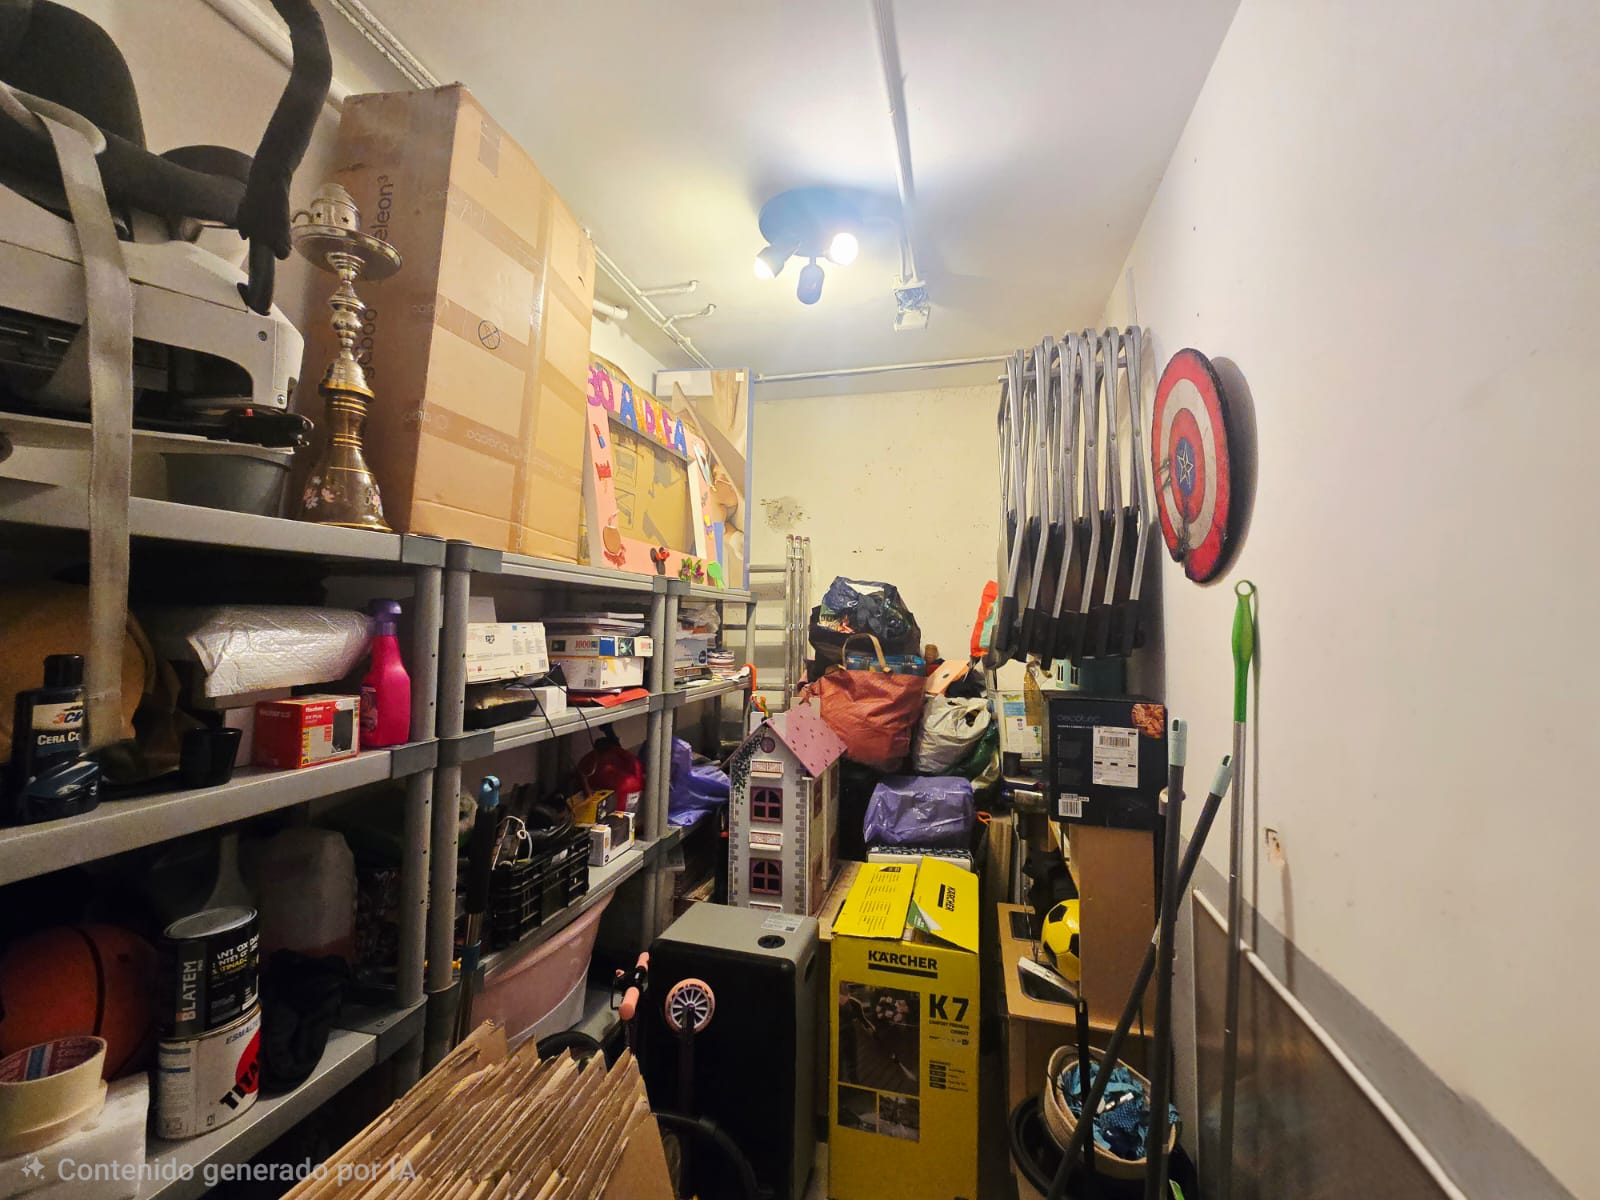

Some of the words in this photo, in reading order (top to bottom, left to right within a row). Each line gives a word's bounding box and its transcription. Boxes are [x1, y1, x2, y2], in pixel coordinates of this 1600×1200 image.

[620, 382, 688, 457] ANDREA
[67, 731, 81, 742] CO
[868, 949, 938, 970] KÄRCHER
[182, 960, 197, 1022] BLATEM
[226, 1020, 258, 1045] ESMALT
[219, 1054, 260, 1110] TITA
